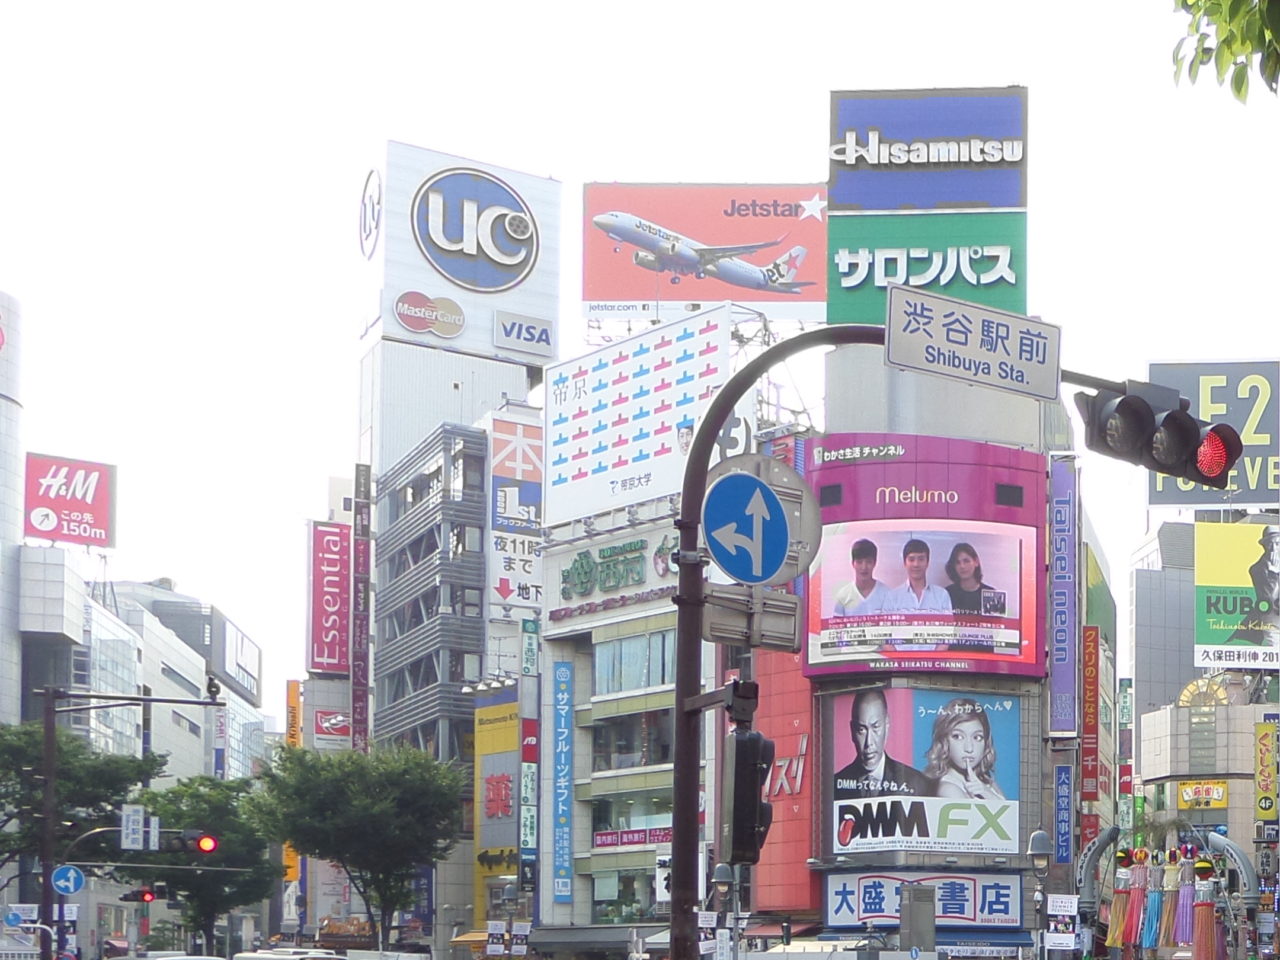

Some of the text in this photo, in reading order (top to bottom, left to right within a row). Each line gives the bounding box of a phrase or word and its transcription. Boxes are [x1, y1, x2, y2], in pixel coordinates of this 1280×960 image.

[830, 131, 1023, 164] Hisamitsu
[724, 199, 801, 217] Jetstar
[835, 246, 1015, 287] サロンパス
[396, 302, 464, 326] MasterCard
[588, 303, 638, 312] jetstar.com
[502, 320, 551, 346] VISA
[902, 299, 1049, 366] 渋谷駅前
[925, 344, 1030, 385] Shibuya Sta.
[492, 424, 543, 480] 本
[824, 445, 905, 461] わかさ生活 チャンネル
[38, 465, 100, 504] H&M
[620, 473, 653, 491] 帝京大学
[61, 510, 95, 524] この先
[61, 520, 106, 540] 150m
[494, 535, 543, 558] 夜11時
[503, 557, 533, 574] まで
[1053, 491, 1073, 664] Taisei neon
[314, 525, 341, 667] Essential
[517, 582, 543, 601] 地下
[935, 661, 969, 669] CHANNEL
[1201, 650, 1259, 663] 久保田利伸
[1085, 631, 1096, 726] クスリのことなら
[556, 692, 570, 814] サマーフルーツギフト
[1083, 734, 1098, 792] 三千里
[485, 772, 513, 818] 薬
[1259, 798, 1273, 808] 4F
[838, 800, 1012, 841] DMM FX
[1058, 772, 1069, 857] 大盛堂商事ビル
[834, 880, 1012, 916] 大盛書店
